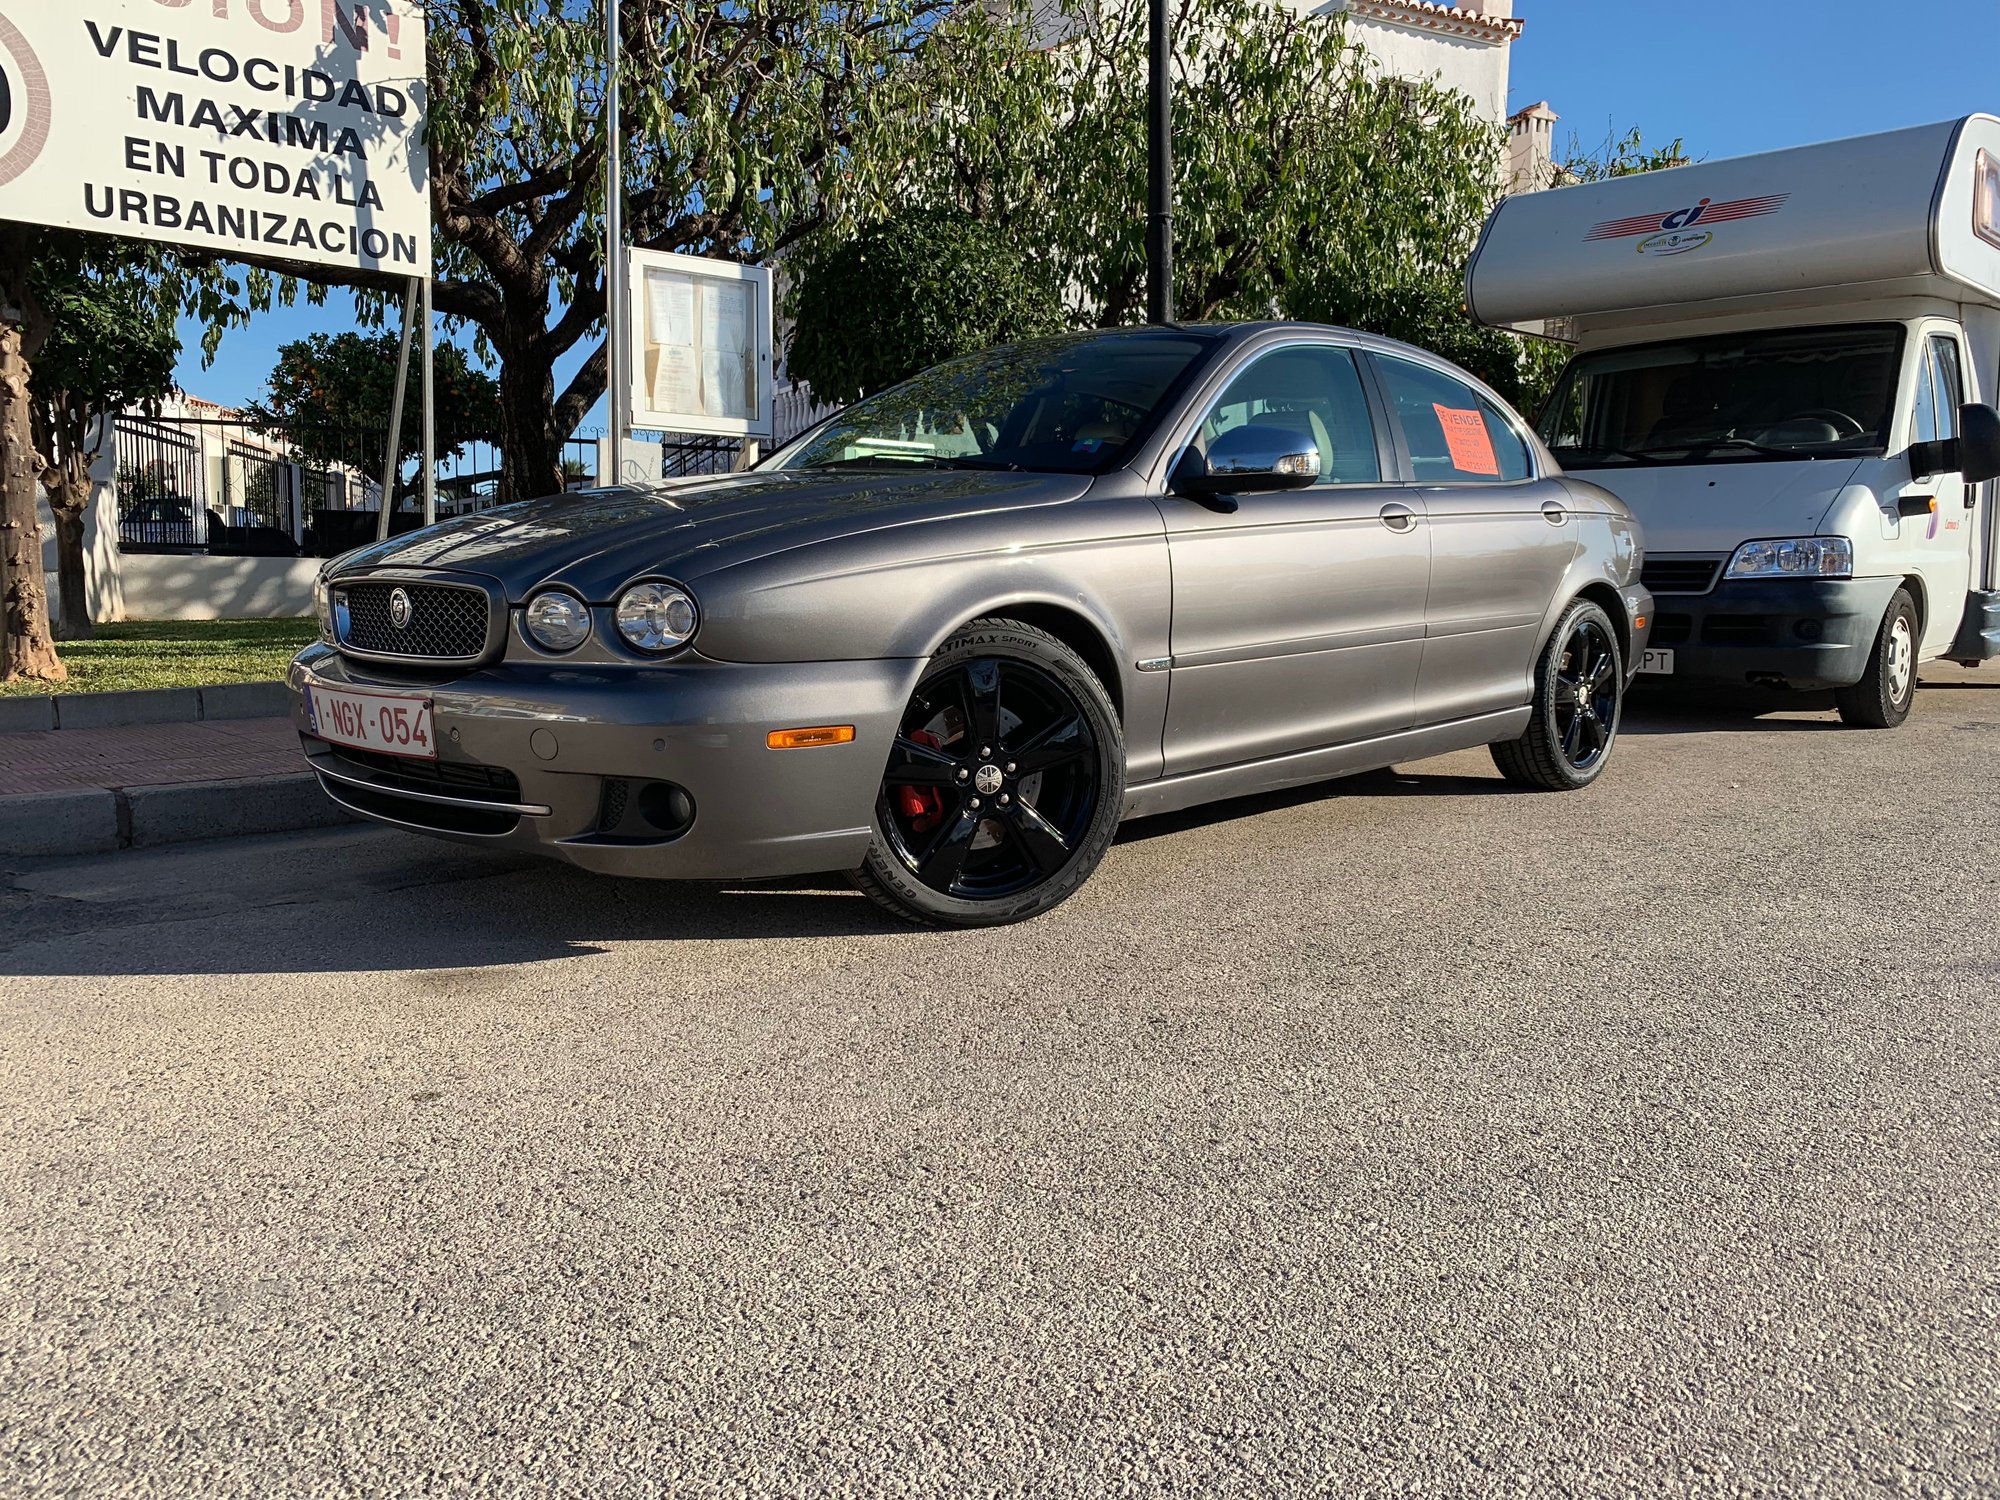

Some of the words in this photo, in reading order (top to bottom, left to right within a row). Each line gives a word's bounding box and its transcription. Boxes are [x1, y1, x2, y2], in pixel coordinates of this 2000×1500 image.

[83, 20, 407, 118] VELOCIDAD
[136, 85, 368, 161] MAXIMA
[125, 136, 185, 178] EN
[200, 150, 320, 201] TODA
[335, 170, 384, 211] LA
[83, 183, 417, 264] URBANIZACION
[1447, 413, 1482, 426] VENDE
[1001, 635, 1039, 648] SPORT
[314, 696, 427, 747] 1-NGX-054
